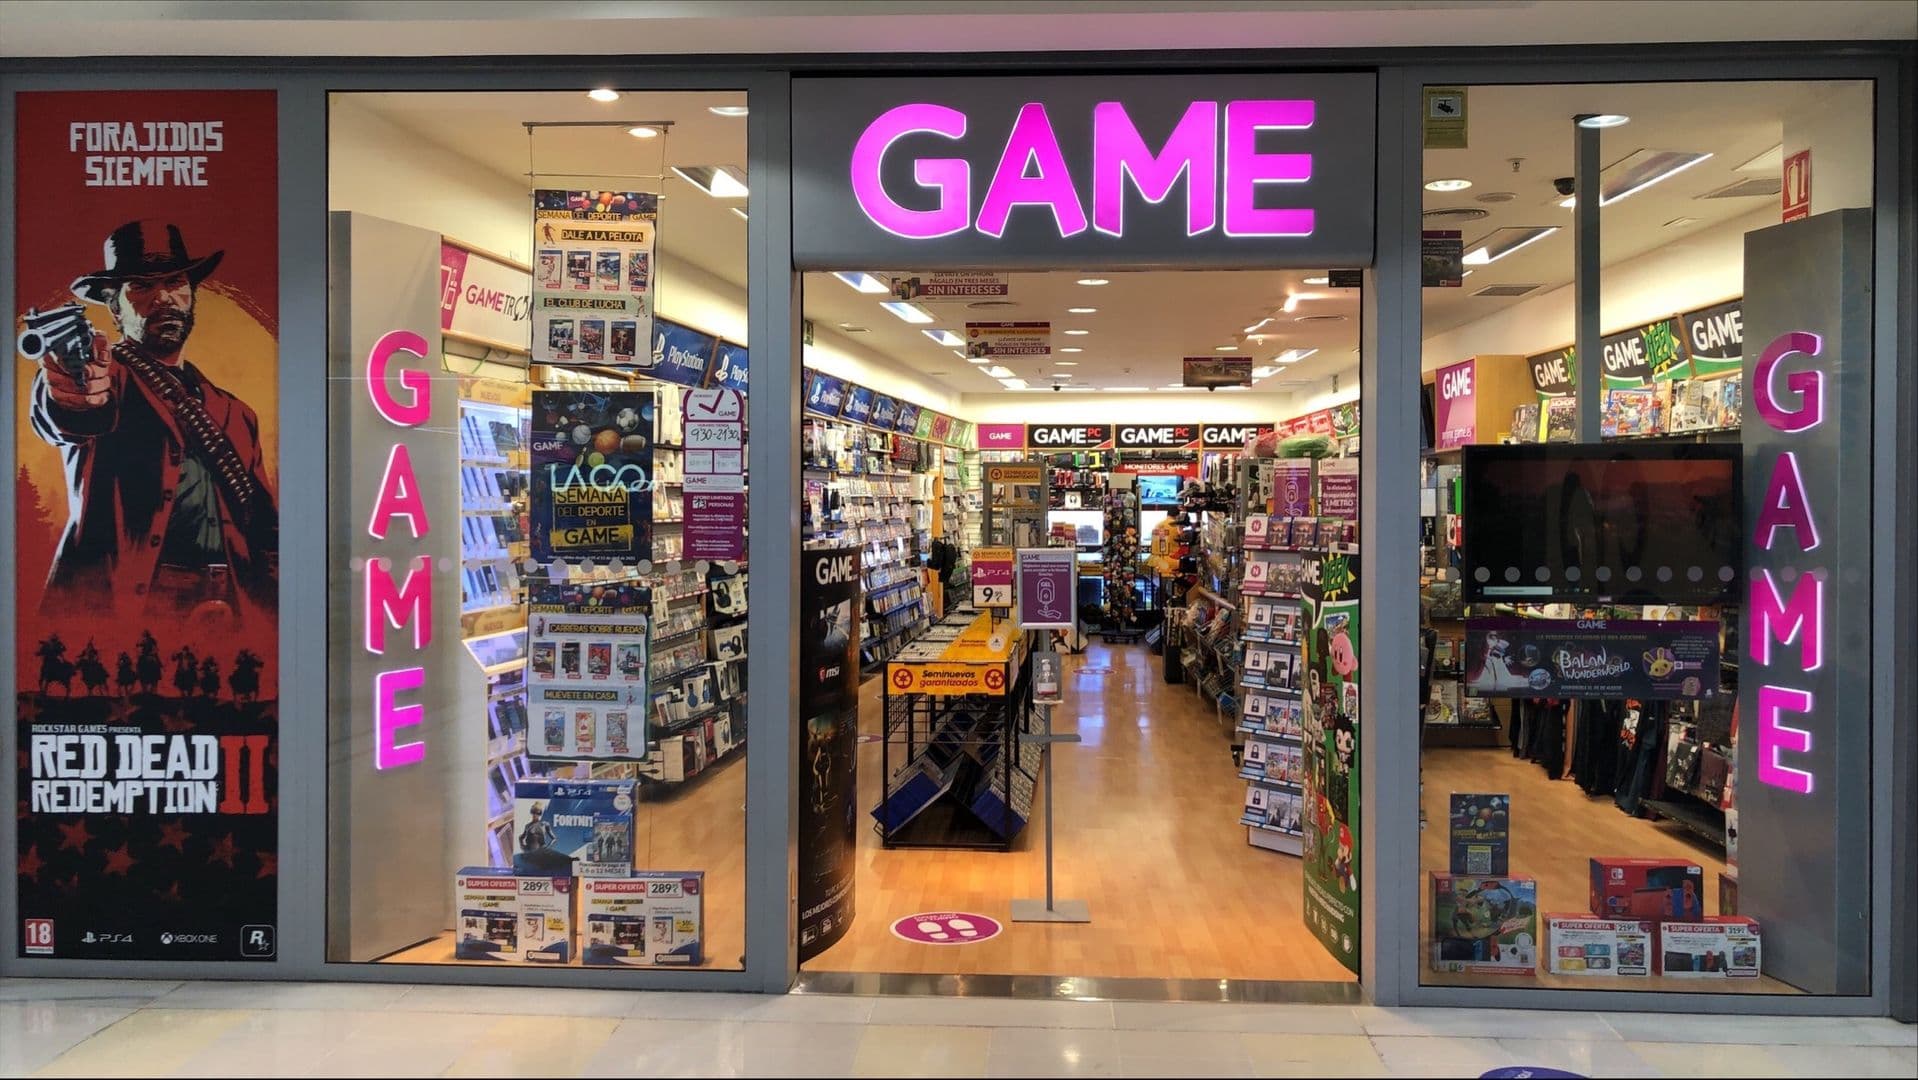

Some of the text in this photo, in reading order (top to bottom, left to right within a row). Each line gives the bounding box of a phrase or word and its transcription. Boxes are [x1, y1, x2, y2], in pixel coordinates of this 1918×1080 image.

[70, 121, 223, 152] FORAJIDOS
[86, 156, 208, 186] SIEMPRE
[851, 99, 1315, 239] GAME
[538, 211, 571, 219] SEMANA
[588, 212, 621, 220] DEPORTE
[562, 230, 643, 242] DALE A LA PELOTA
[928, 286, 1001, 295] SIN INTERESES
[558, 298, 580, 308] CLUB
[582, 299, 593, 308] DE
[595, 300, 624, 309] LUCHA
[1692, 310, 1743, 351] GAME
[1604, 320, 1675, 371] GAME GEEK
[667, 345, 704, 371] PlayStation
[1535, 358, 1568, 388] GAME
[1443, 366, 1471, 400] GAME
[989, 432, 1012, 440] GAME
[1034, 428, 1101, 444] GAME PC
[1120, 428, 1189, 444] GAME PC
[533, 442, 563, 451] GAME
[557, 487, 625, 503] SEMANA
[558, 505, 625, 517] DEL DEPORTE
[564, 527, 619, 545] GAME
[366, 330, 432, 770] GAME
[816, 555, 853, 585] GAME
[1749, 331, 1824, 794] GAME
[551, 624, 645, 634] CARRERAS SOBRE RUEDAS
[1576, 620, 1607, 630] GAME
[1560, 646, 1607, 673] BALAN
[826, 666, 840, 679] msi
[922, 669, 976, 679] Seminuevos
[1566, 661, 1631, 680] WONDERWORLD
[920, 677, 979, 688] garantizados
[595, 691, 617, 700] CASA
[32, 724, 76, 734] ROCKSTAR
[78, 724, 107, 734] GAMES
[31, 735, 269, 815] RED DEAD II
[31, 780, 217, 814] REDEMPTION
[567, 787, 592, 796] PS4
[553, 813, 594, 828] FORTNIT
[491, 880, 516, 888] OFERTA
[595, 882, 616, 890] SUPER
[618, 882, 644, 890] OFERTA
[27, 922, 51, 945] 18
[99, 934, 133, 943] PS4
